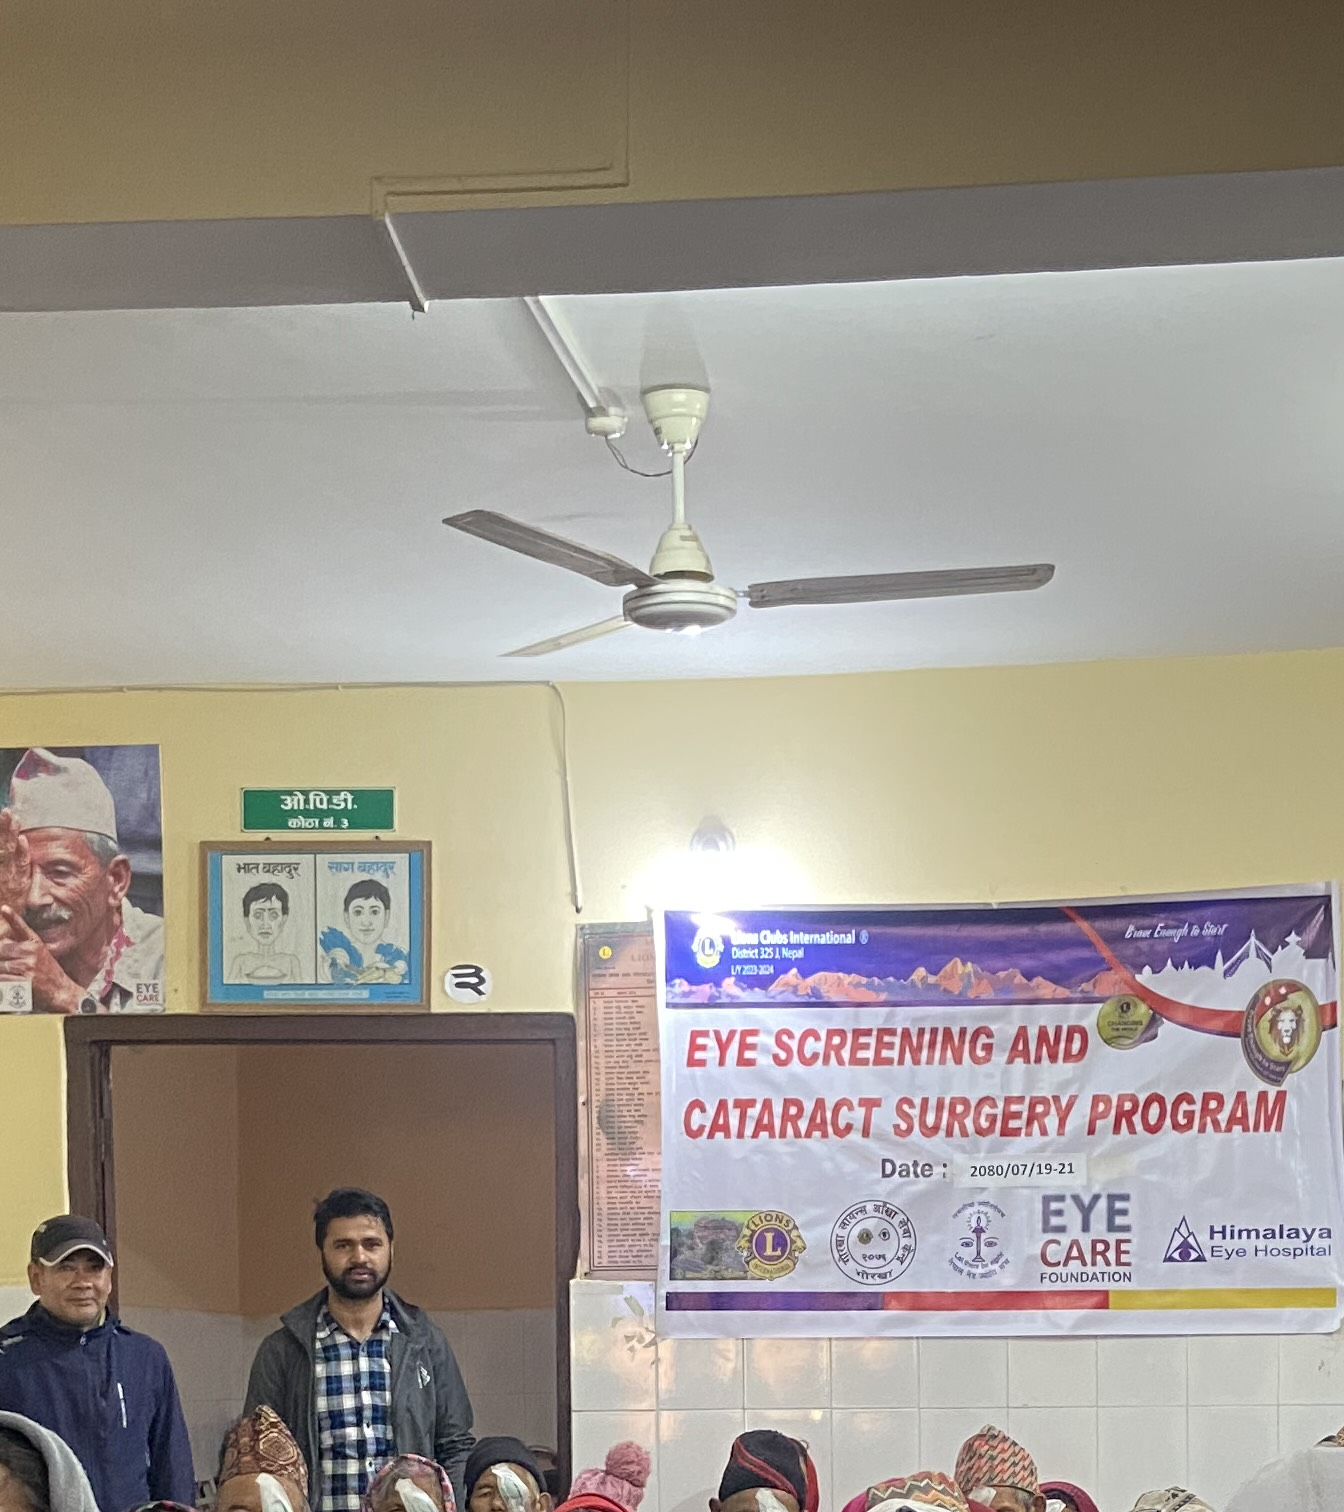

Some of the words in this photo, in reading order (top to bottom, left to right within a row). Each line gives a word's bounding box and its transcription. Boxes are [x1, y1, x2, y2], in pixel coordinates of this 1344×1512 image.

[287, 815, 320, 829] कोठा
[341, 817, 349, 829] ३
[760, 929, 788, 944] Clubs
[789, 929, 856, 945] International
[1190, 924, 1200, 937] to
[731, 946, 758, 959] District
[760, 947, 774, 959] 325
[782, 947, 804, 960] Nepal
[136, 983, 159, 994] EYE
[686, 1029, 760, 1068] EYE
[772, 1025, 996, 1068] SCREENING
[1006, 1024, 1090, 1065] AND
[683, 1097, 882, 1140] CATARACT
[891, 1094, 1079, 1139] SURGERY
[1087, 1089, 1288, 1136] PROGRAM
[880, 1158, 935, 1179] Date
[969, 1162, 1076, 1179] 2080/07/19-21
[751, 1212, 792, 1228] LIONS
[1041, 1193, 1132, 1233] EYE
[1209, 1224, 1332, 1243] Himalaya
[763, 1232, 782, 1256] L
[1040, 1238, 1132, 1268] CARE
[1210, 1245, 1247, 1260] Eye
[1254, 1245, 1332, 1259] Hospital
[1040, 1271, 1132, 1284] FOUNDATION
